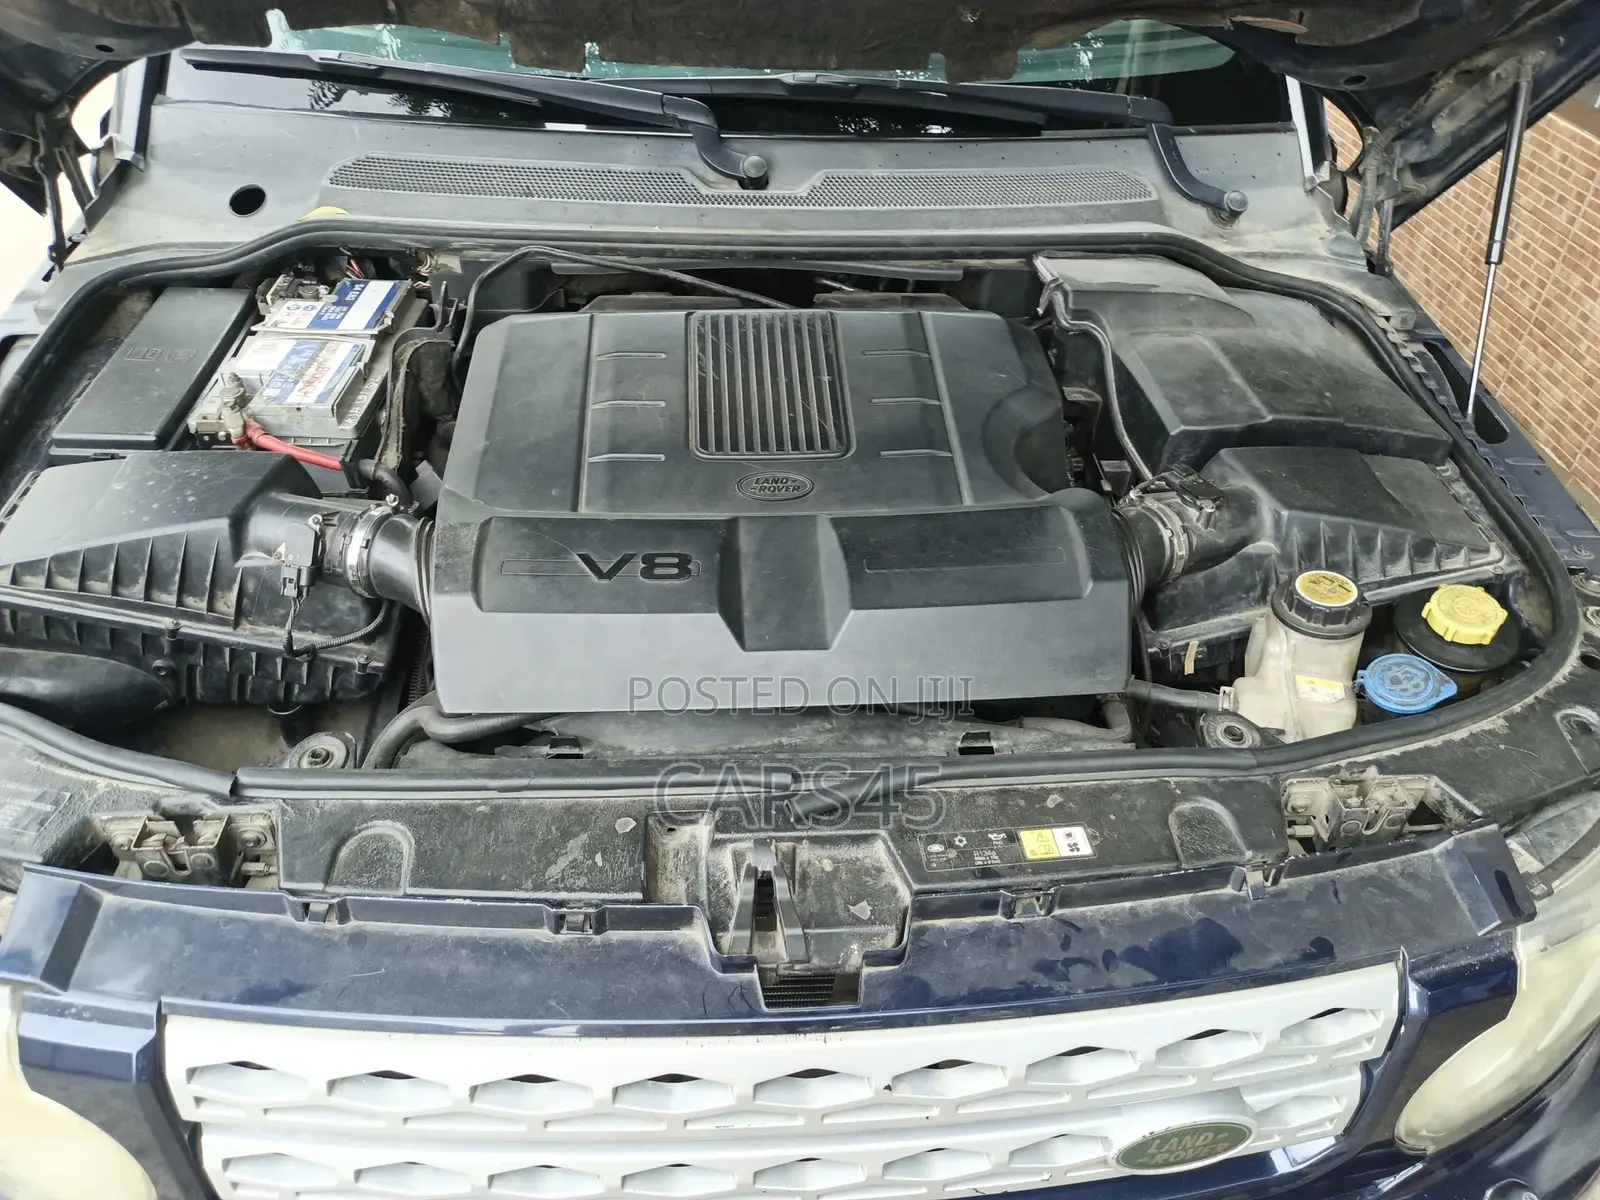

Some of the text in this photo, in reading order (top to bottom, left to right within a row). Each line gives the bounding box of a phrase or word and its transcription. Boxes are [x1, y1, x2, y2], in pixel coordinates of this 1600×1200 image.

[754, 477, 790, 486] LAND
[758, 485, 801, 493] ROVER
[576, 552, 692, 582] V8
[1147, 1132, 1215, 1154] LAND
[1149, 1142, 1230, 1165] ROVER
